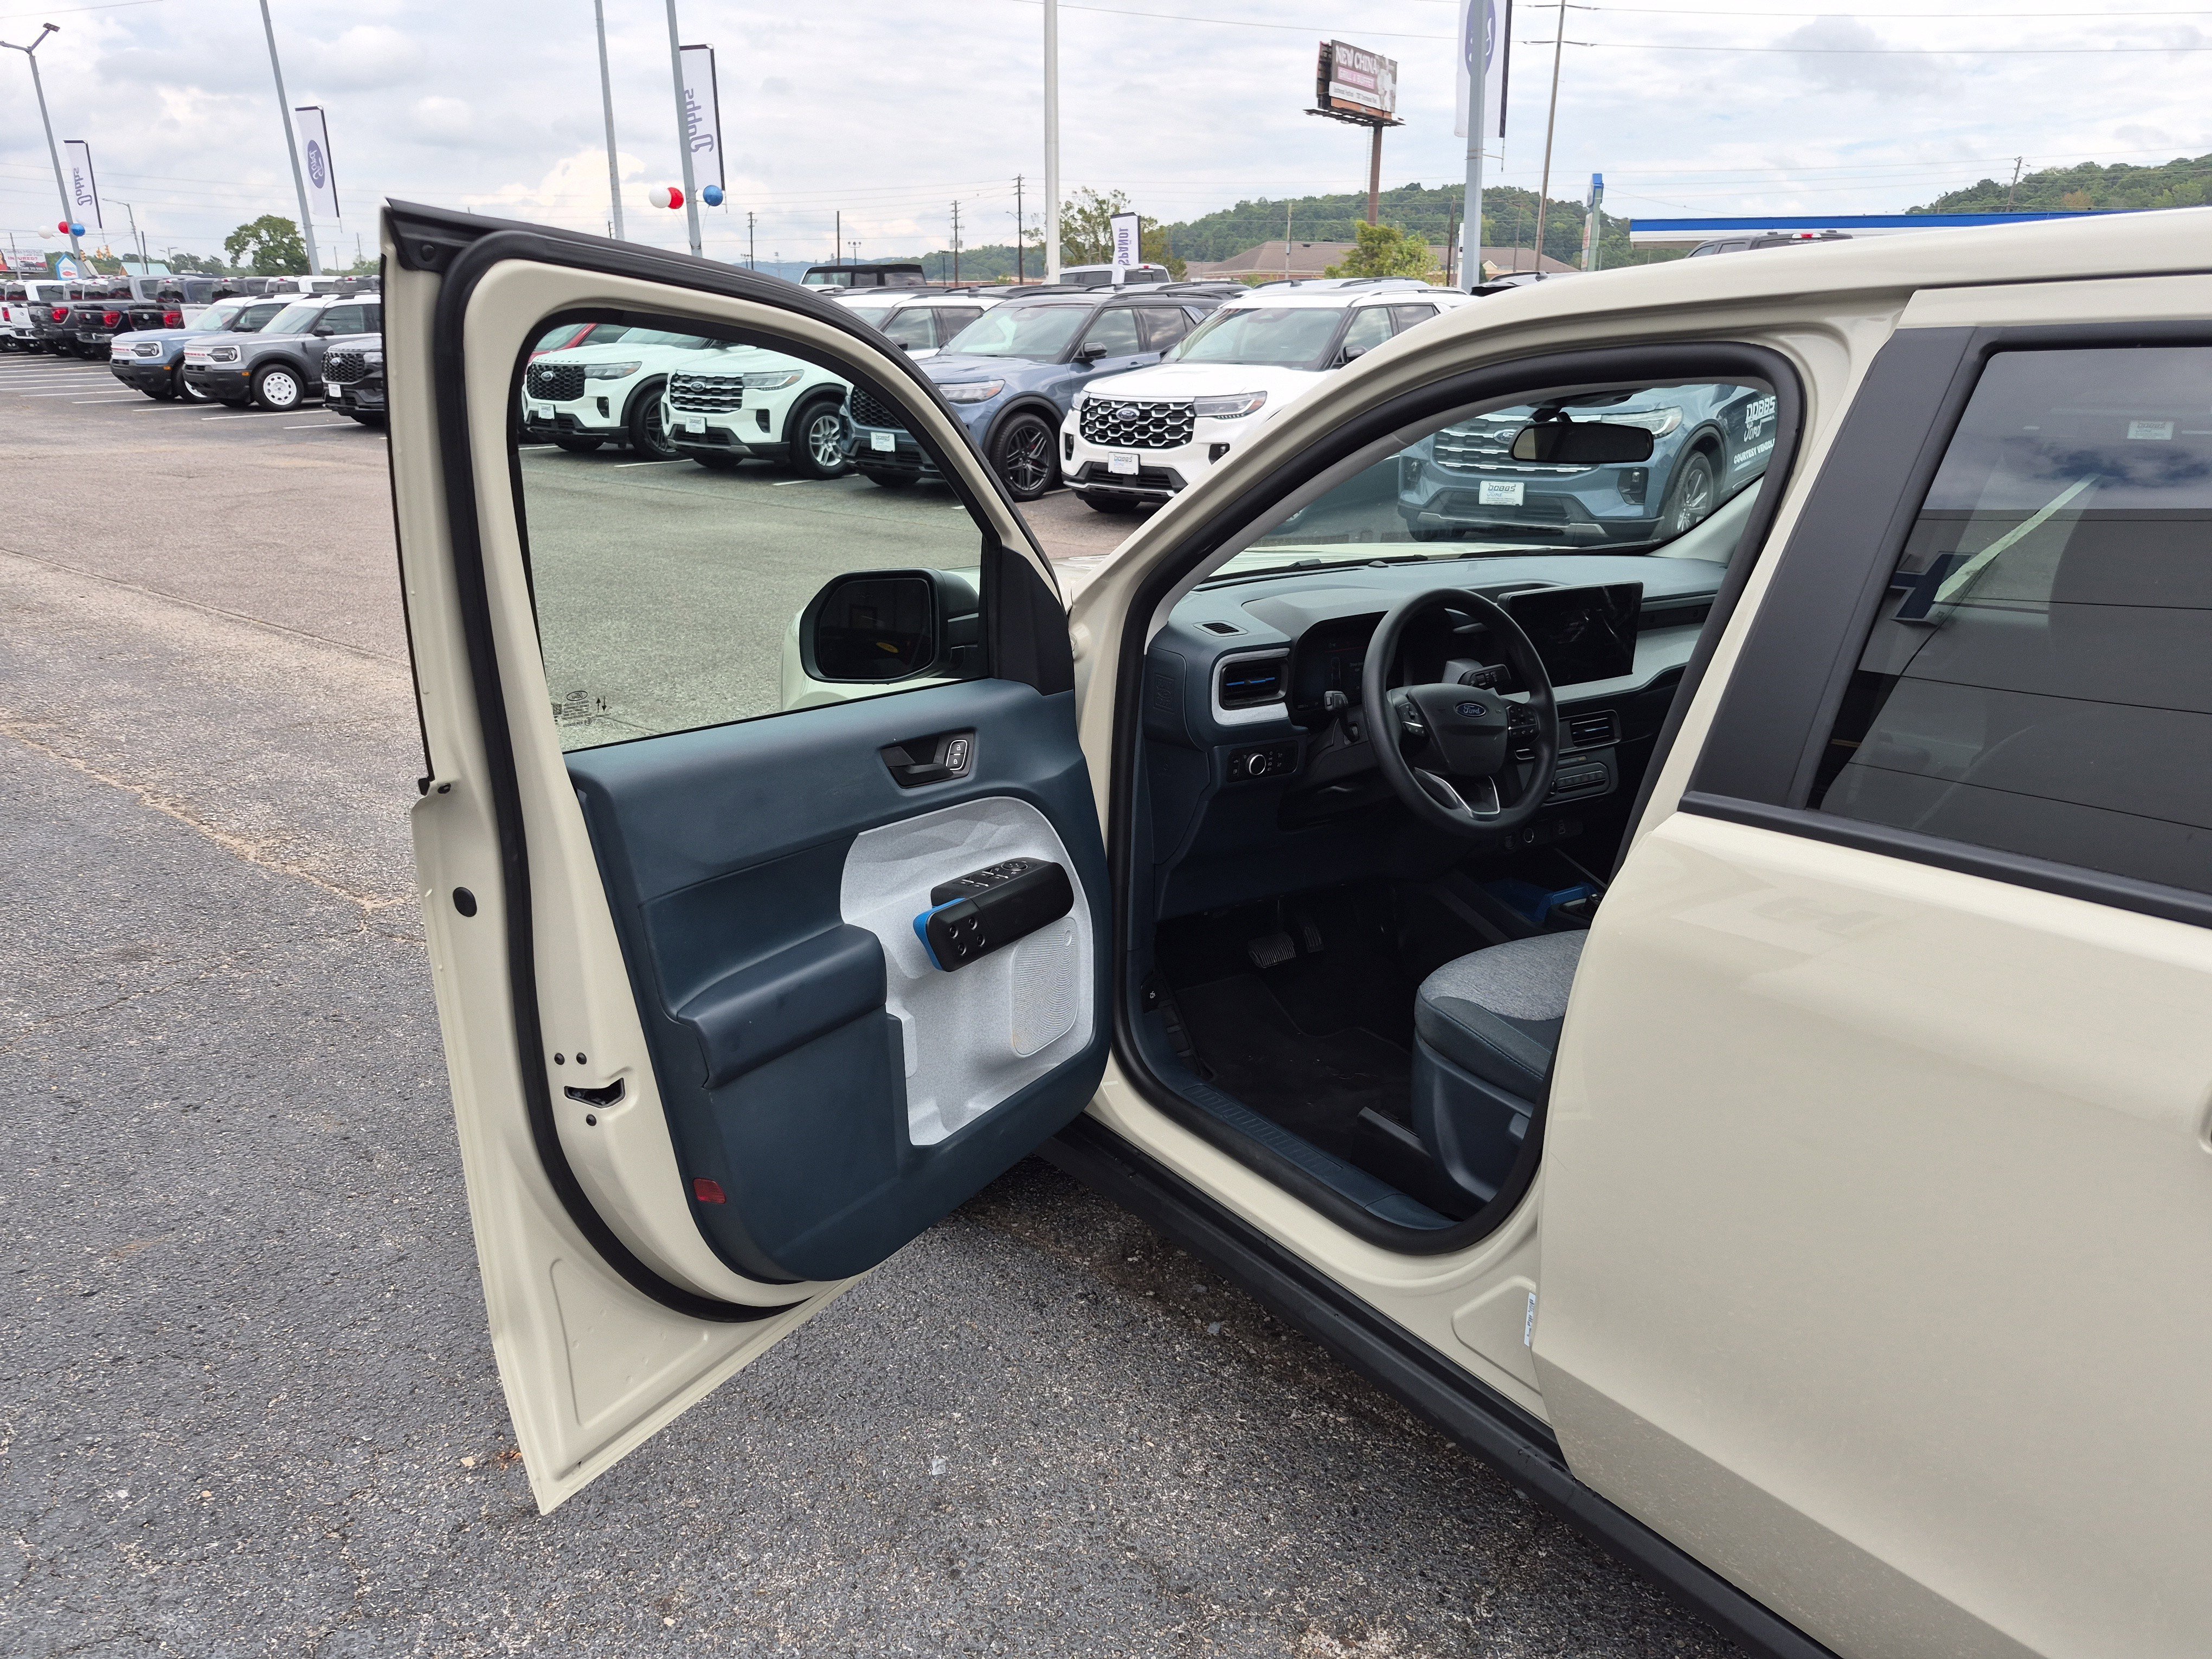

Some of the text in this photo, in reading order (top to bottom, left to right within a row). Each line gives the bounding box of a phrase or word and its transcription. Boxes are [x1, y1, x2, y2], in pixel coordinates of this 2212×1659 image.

[1335, 44, 1378, 75] NEW CHINA
[1746, 396, 1776, 418] DOBBS
[1463, 705, 1480, 714] Ford
